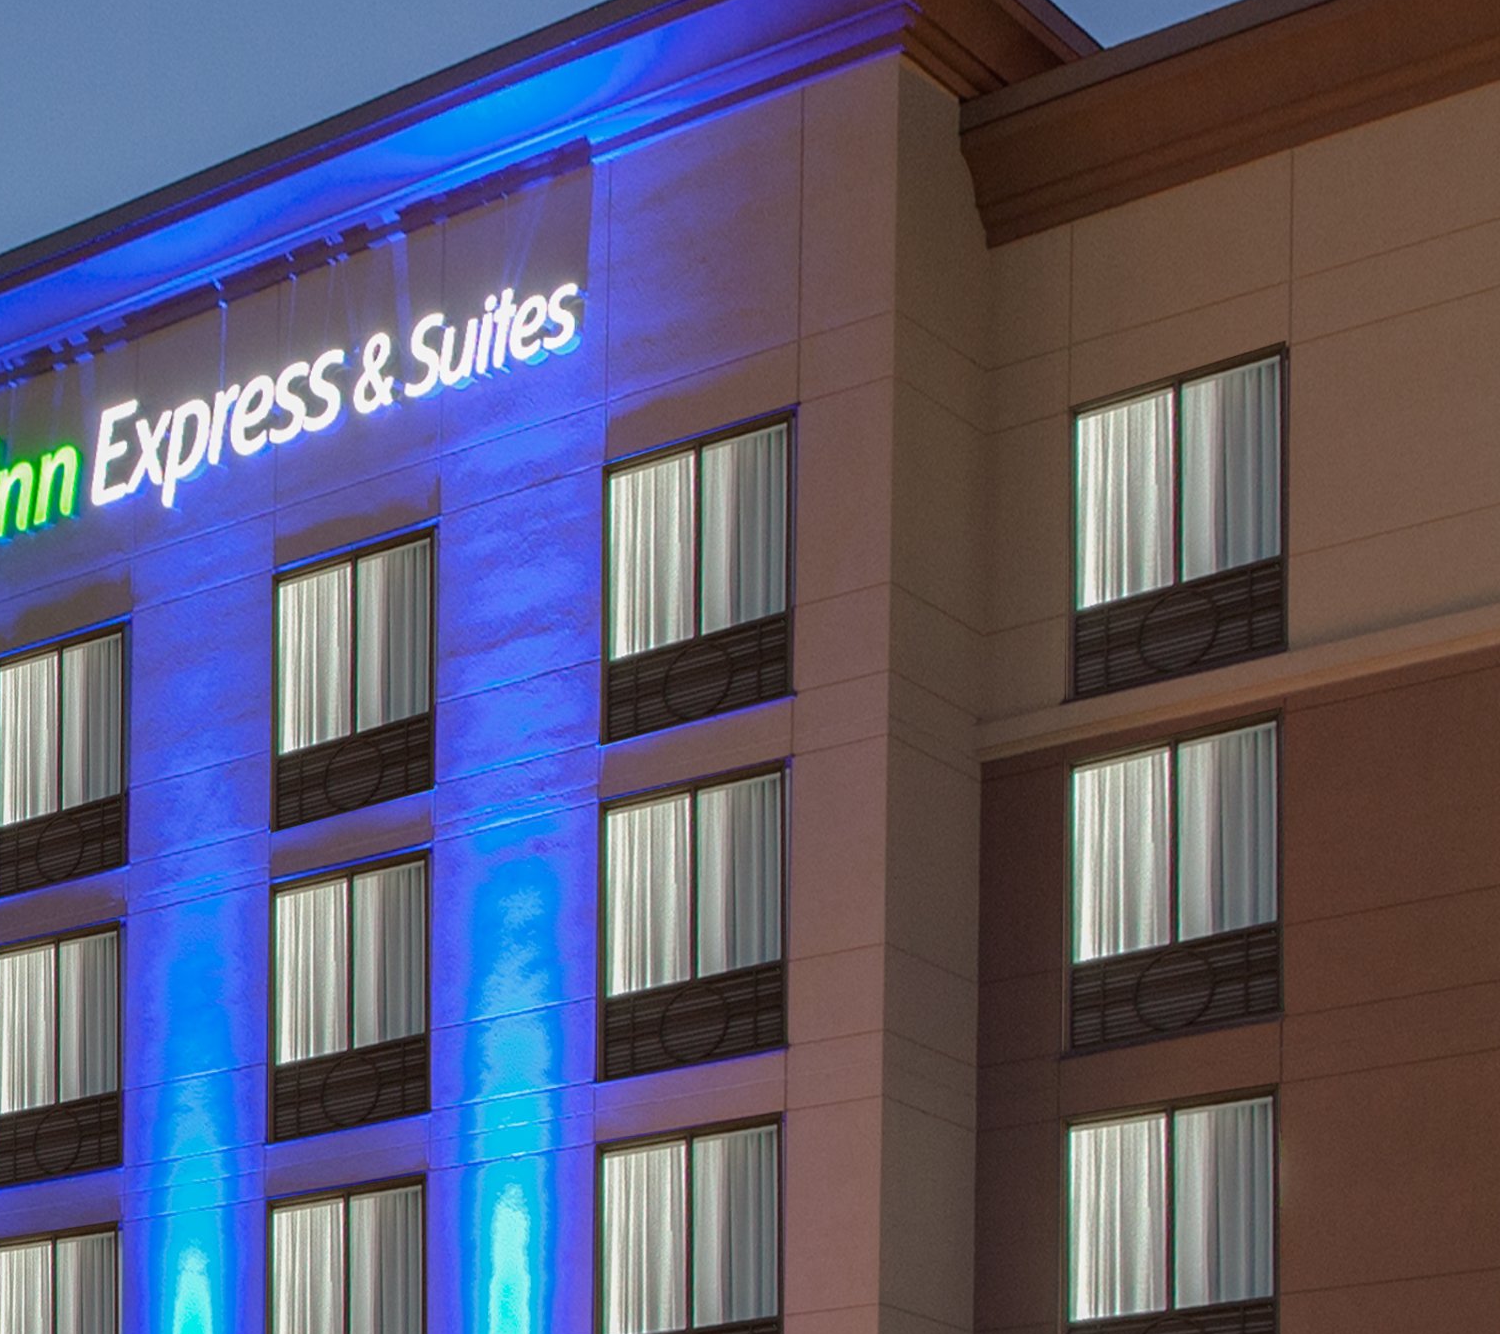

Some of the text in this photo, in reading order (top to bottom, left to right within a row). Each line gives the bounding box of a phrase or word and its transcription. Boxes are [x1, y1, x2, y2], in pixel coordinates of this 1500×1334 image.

[90, 348, 346, 509] Express
[352, 331, 394, 415] &
[404, 282, 579, 399] Suites
